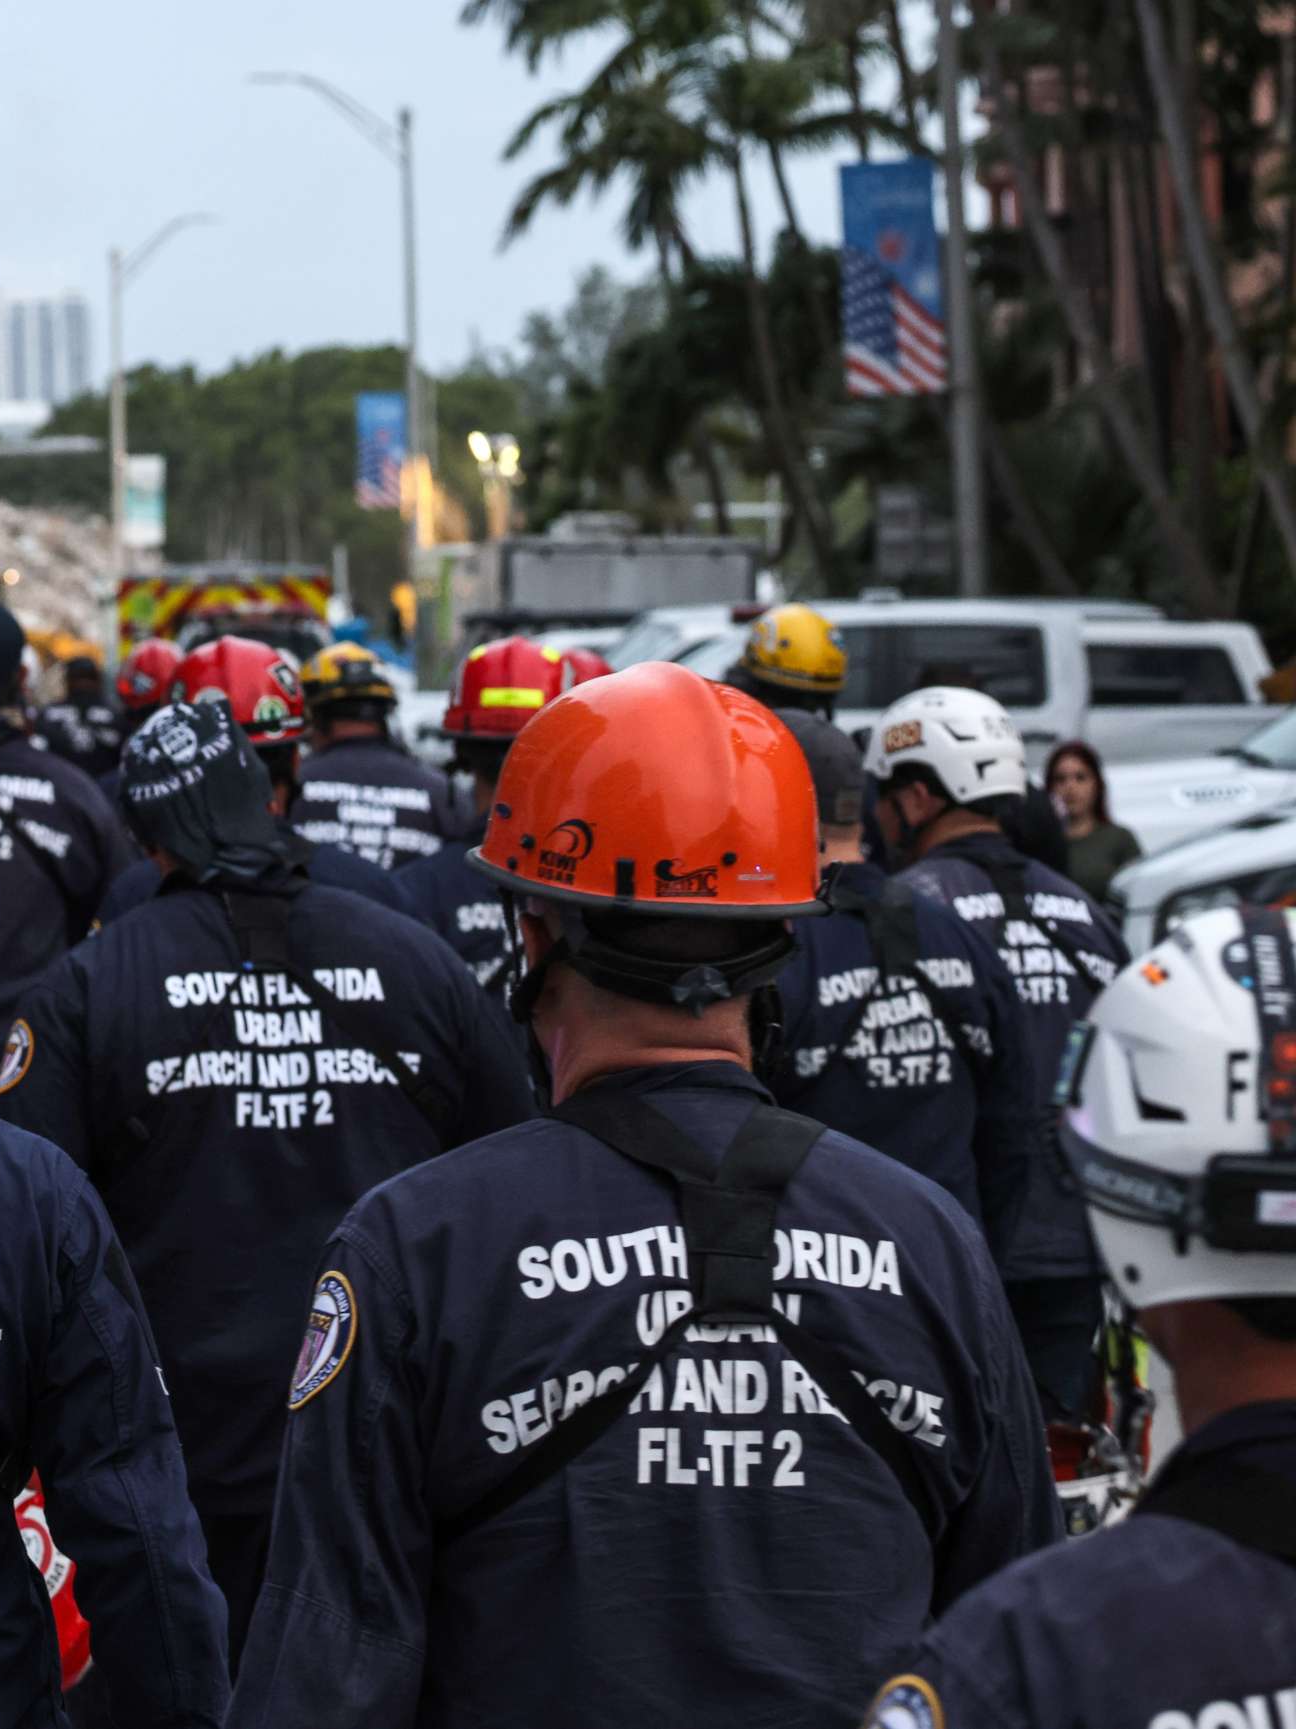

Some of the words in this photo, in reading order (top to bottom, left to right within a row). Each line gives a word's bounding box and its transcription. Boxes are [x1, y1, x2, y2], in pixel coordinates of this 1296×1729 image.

[540, 849, 577, 872] KIWI
[234, 1010, 323, 1047] URBAN
[935, 1052, 952, 1083] 2
[312, 1090, 334, 1125] 2
[517, 1225, 689, 1300] SOUTH
[670, 1358, 768, 1415] AND
[637, 1427, 764, 1487] FL-TF
[771, 1429, 805, 1487] 2
